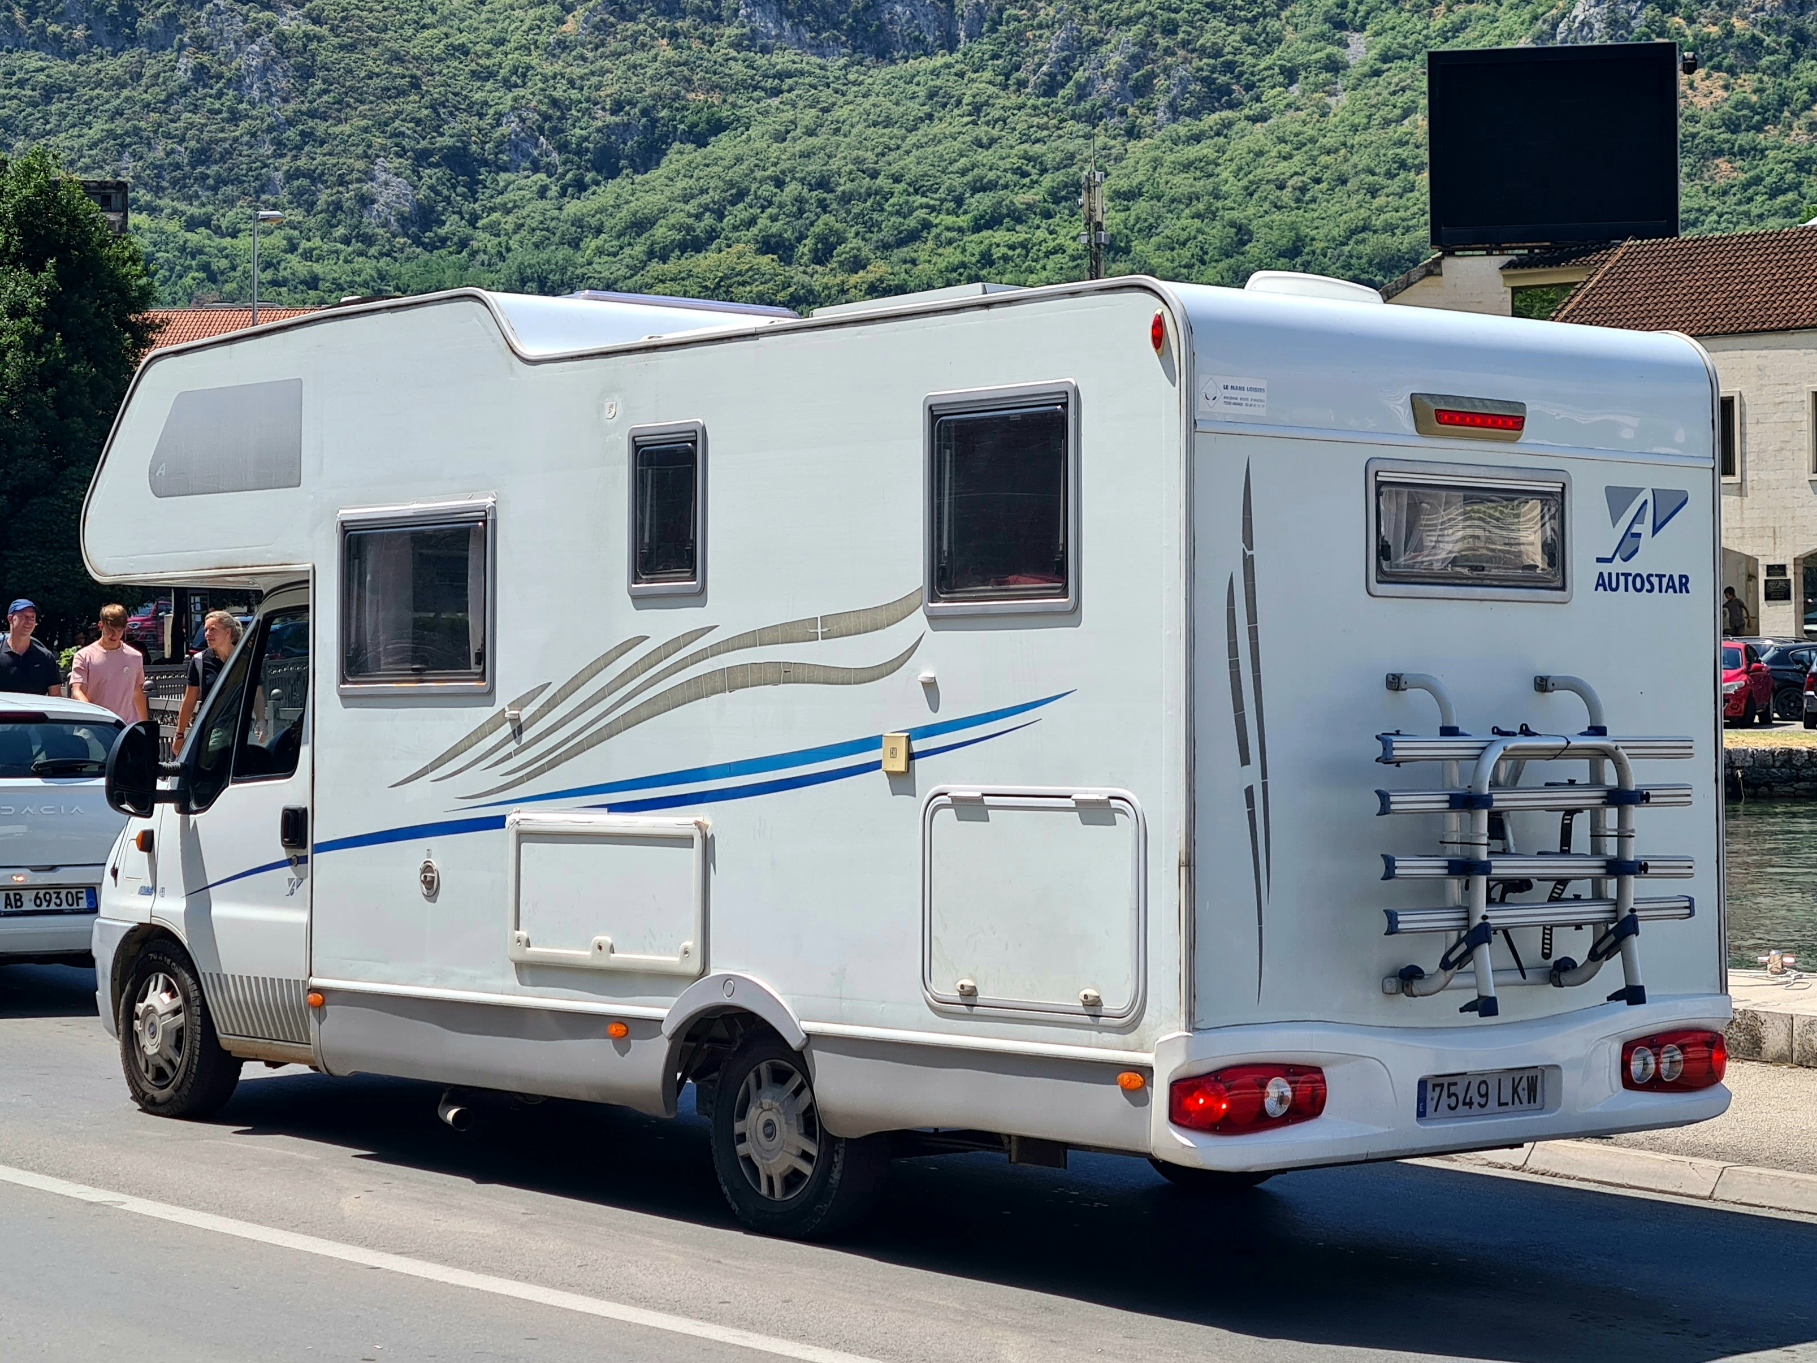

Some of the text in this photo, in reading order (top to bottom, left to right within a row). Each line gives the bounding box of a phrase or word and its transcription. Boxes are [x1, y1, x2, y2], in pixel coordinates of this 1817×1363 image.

[1594, 571, 1690, 594] AUTOSTAR
[0, 805, 85, 815] DACIA
[4, 892, 24, 910] AB
[1431, 1075, 1538, 1113] 7549 LKW
